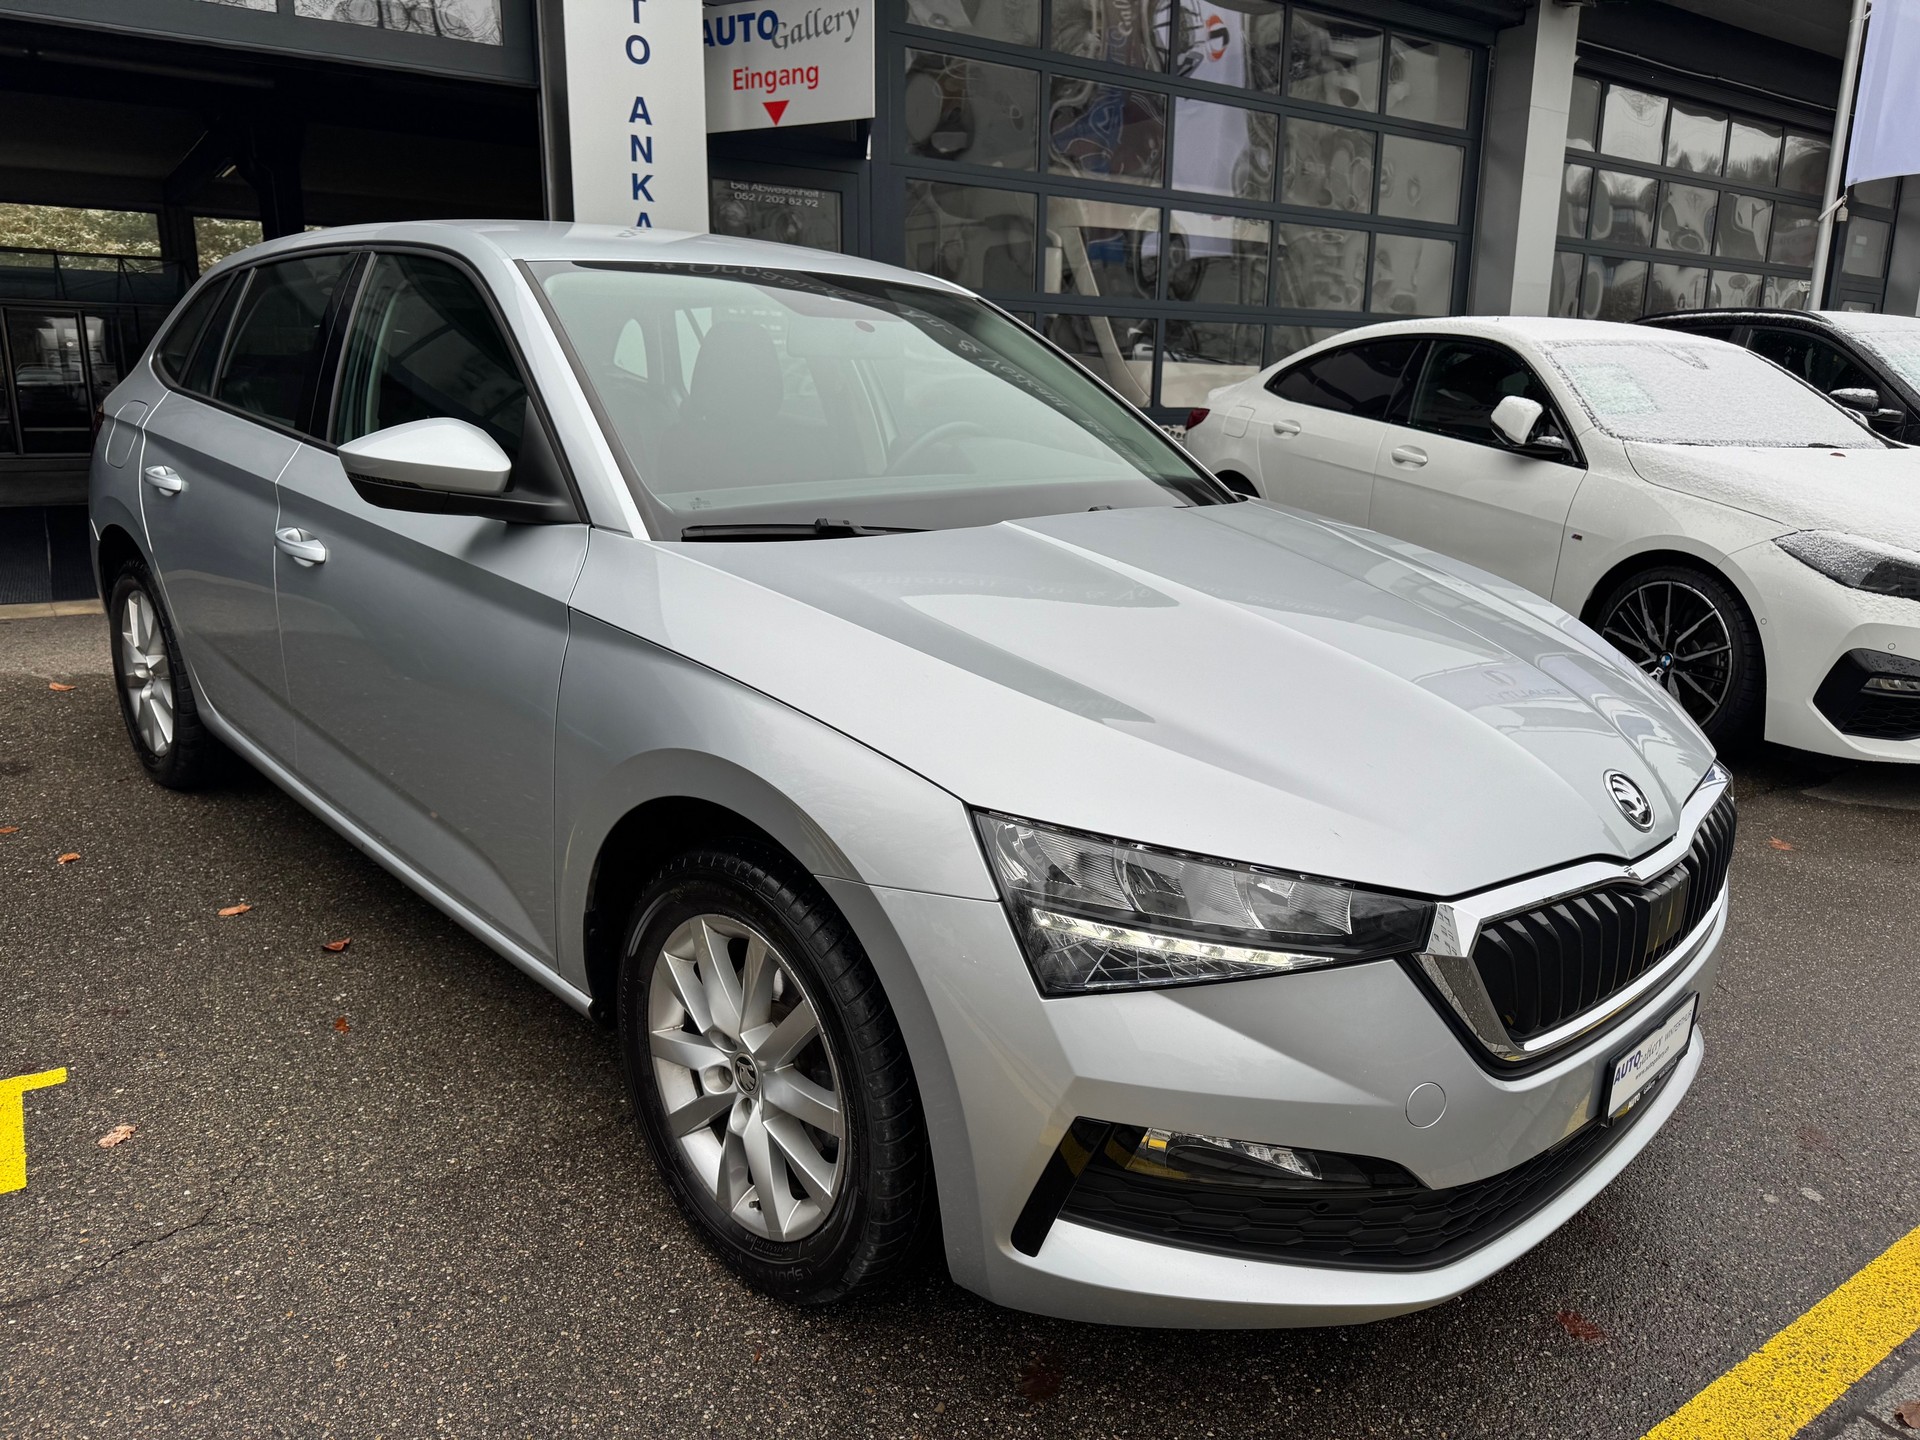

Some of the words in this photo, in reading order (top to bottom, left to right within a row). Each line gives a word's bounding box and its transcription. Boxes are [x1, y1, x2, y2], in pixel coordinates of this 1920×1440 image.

[703, 9, 779, 47] AUTO
[771, 6, 860, 50] Gallery
[732, 65, 819, 94] Eingang
[730, 181, 749, 191] bei
[734, 191, 756, 201] 052
[765, 195, 786, 204] 202
[804, 199, 819, 208] 92
[1613, 1050, 1642, 1085] AUTO
